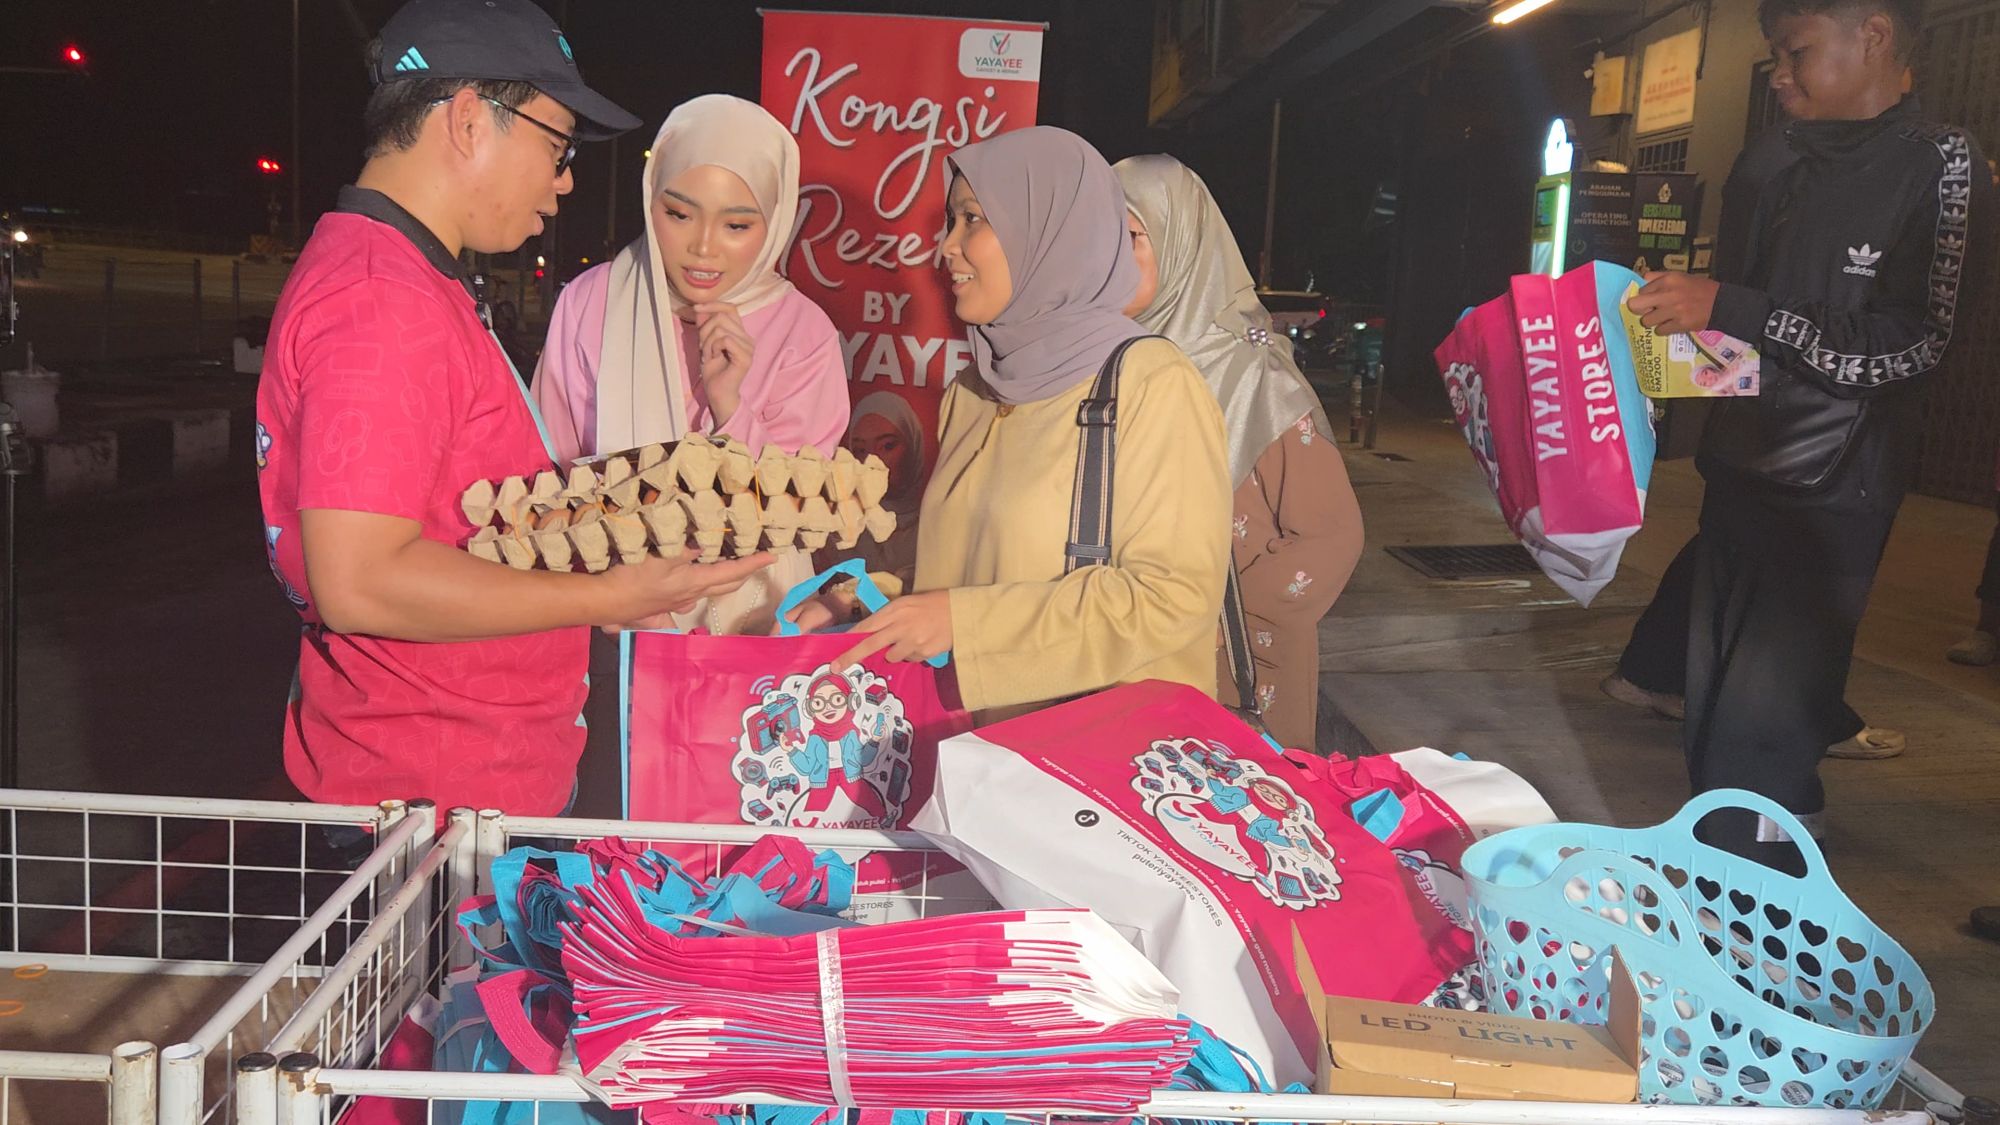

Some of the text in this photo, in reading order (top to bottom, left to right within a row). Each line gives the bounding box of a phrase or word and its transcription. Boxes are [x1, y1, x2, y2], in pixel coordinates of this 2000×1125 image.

[975, 56, 1023, 69] YAYAYEE
[785, 47, 1006, 218] Kongsi
[1581, 212, 1628, 220] OPERATING
[1843, 265, 1876, 278] adidas
[863, 291, 911, 324] BY
[838, 329, 971, 388] YAYE
[1522, 315, 1567, 461] YAYAYEE
[1575, 316, 1621, 443] STORES
[822, 816, 880, 829] YAYAYEE
[1197, 822, 1259, 870] YAYAYEE
[1116, 829, 1223, 928] TIKTOK YAYAYEESTORES
[1360, 1013, 1432, 1032] LED
[1457, 1026, 1579, 1051] LIGHT
[1408, 1012, 1521, 1031] PHOTO & VIDEO
